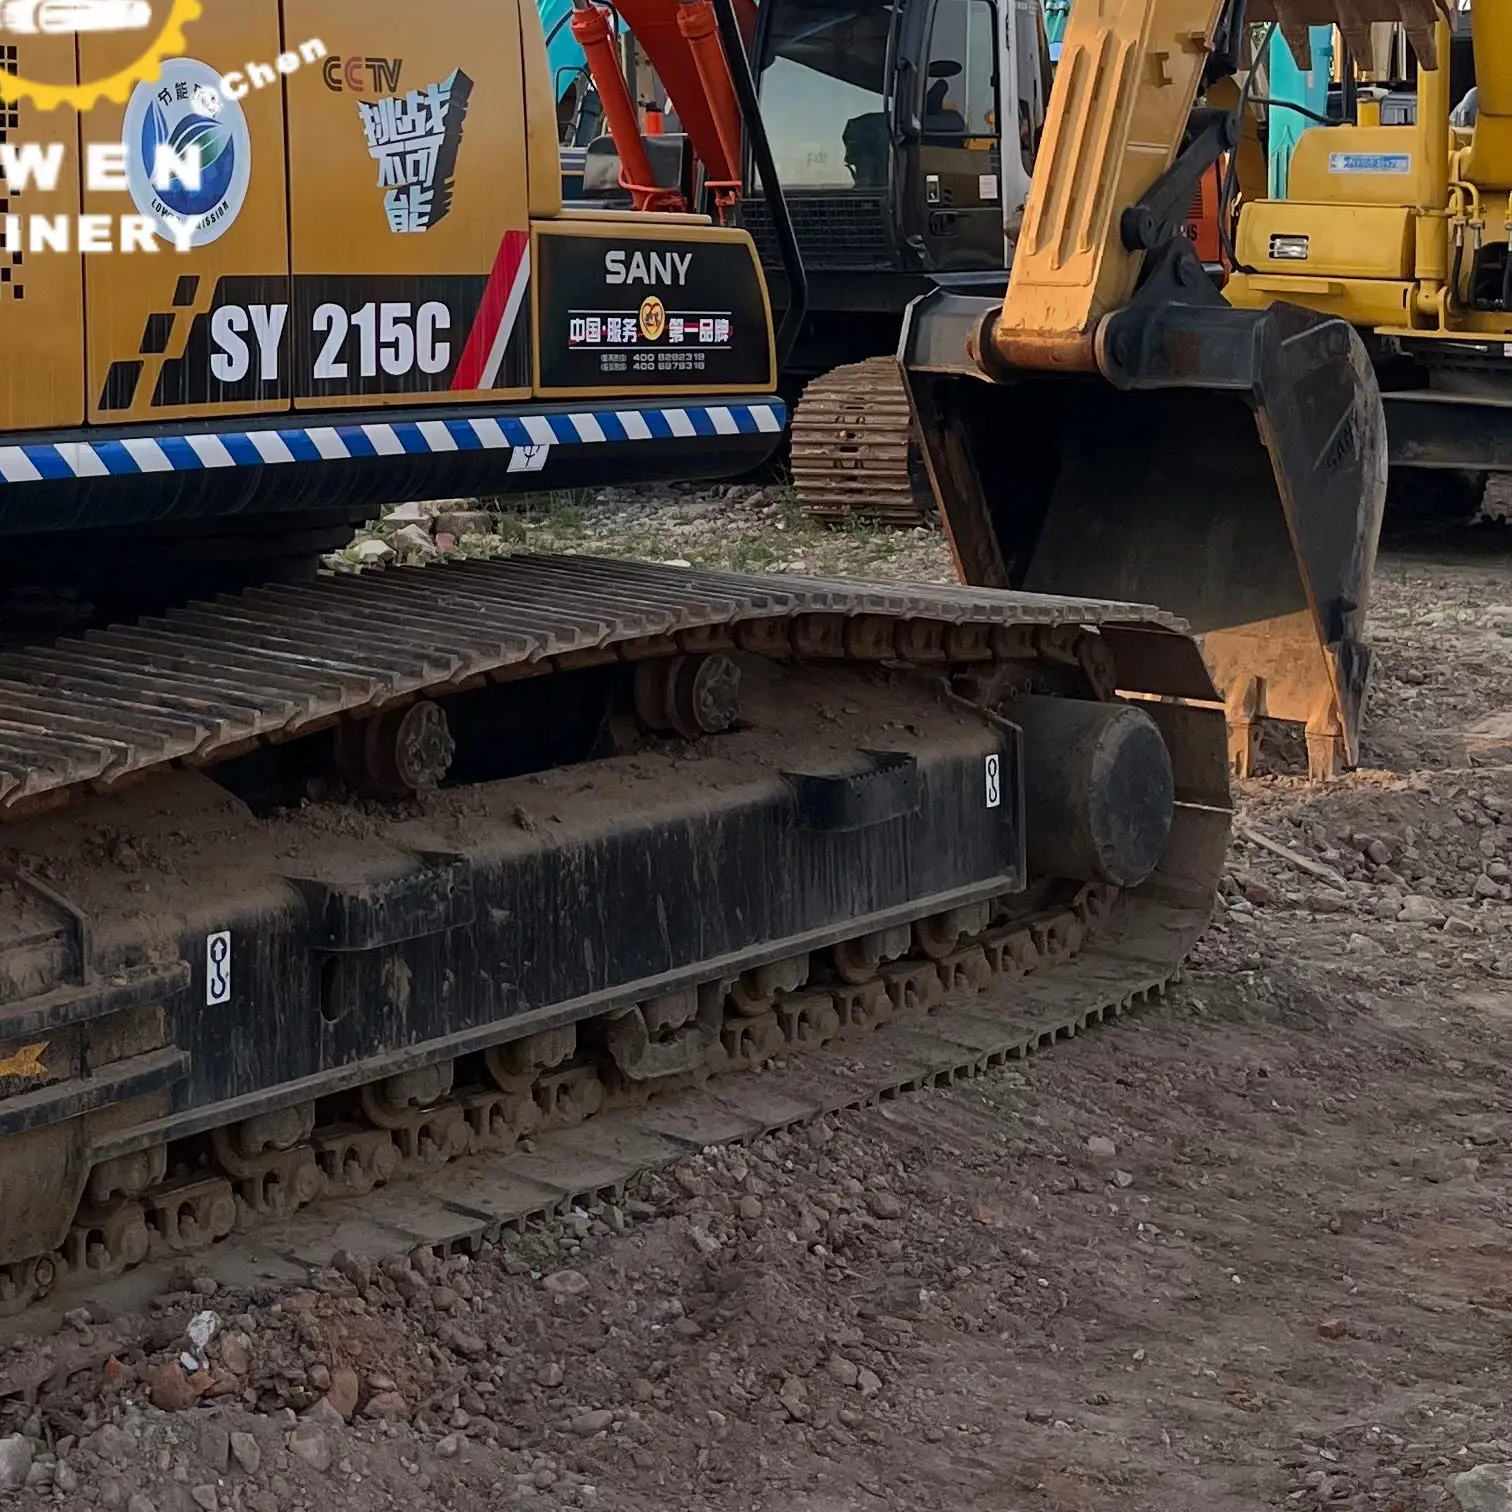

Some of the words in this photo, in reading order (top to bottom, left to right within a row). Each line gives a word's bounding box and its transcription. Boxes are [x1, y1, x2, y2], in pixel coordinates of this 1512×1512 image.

[322, 55, 404, 94] CCTV
[604, 249, 694, 286] SANY
[209, 303, 289, 382] SY
[312, 301, 453, 380] 215C
[632, 353, 655, 362] 400
[632, 362, 655, 370] 400
